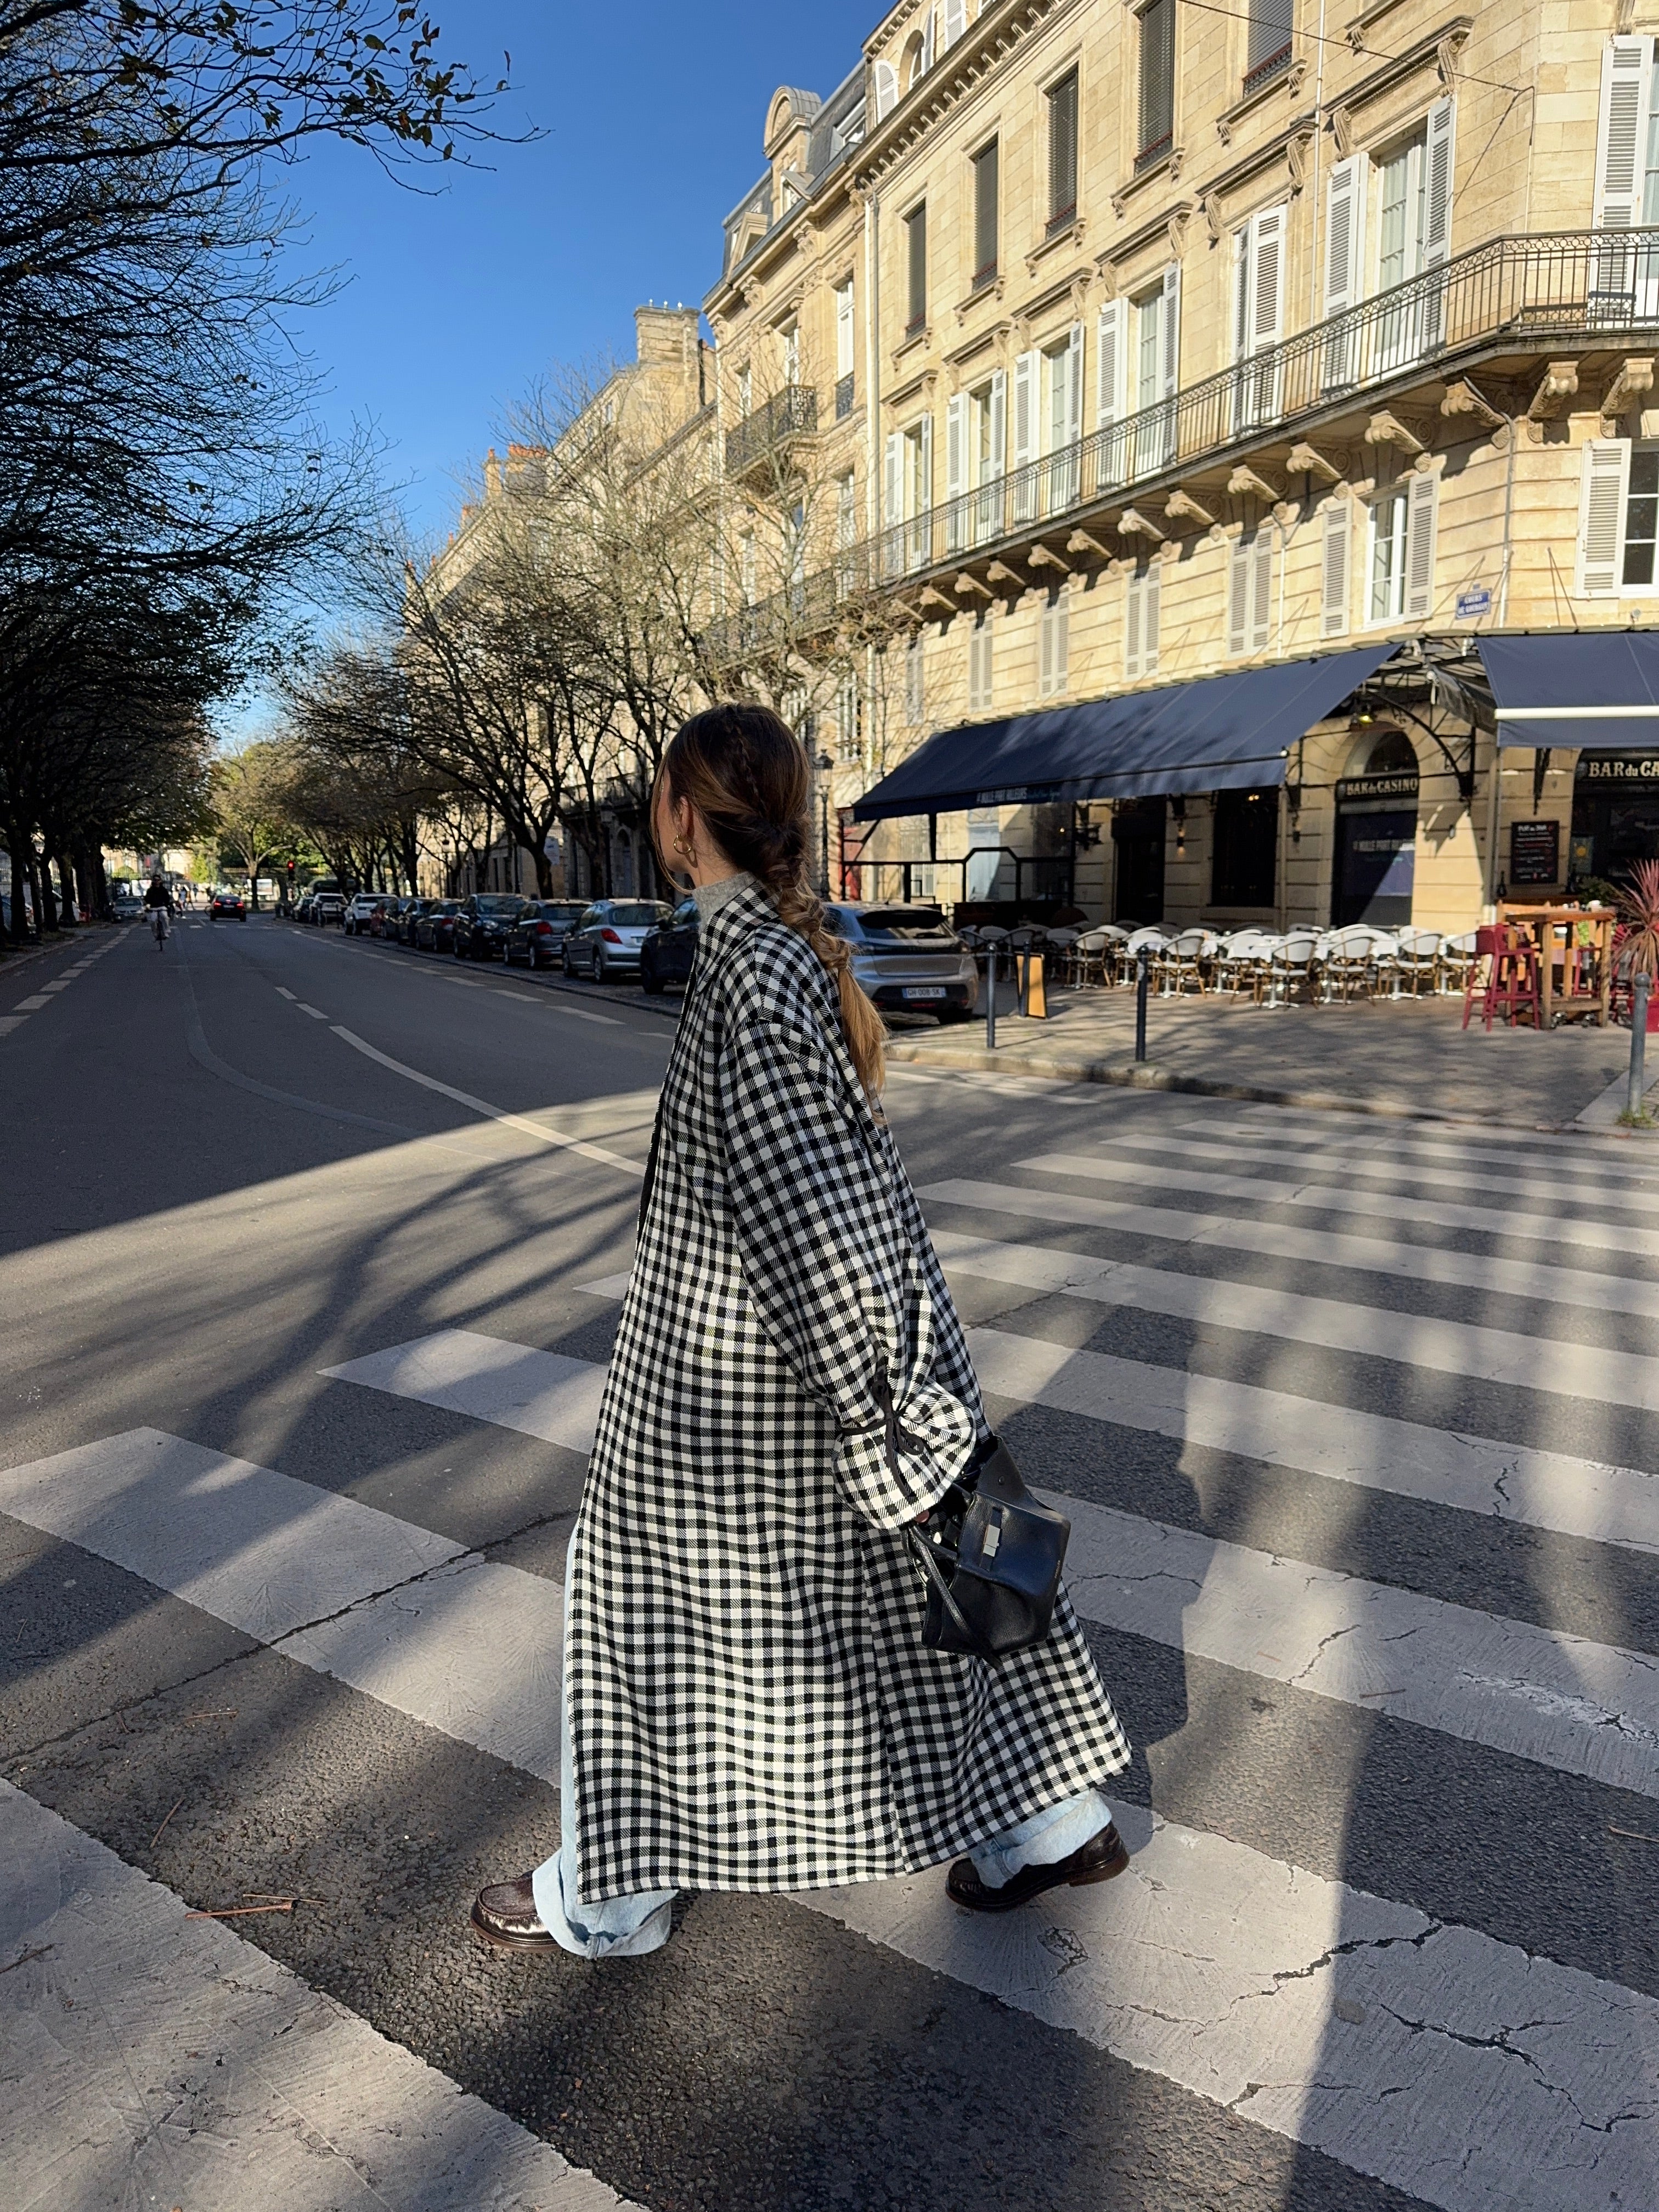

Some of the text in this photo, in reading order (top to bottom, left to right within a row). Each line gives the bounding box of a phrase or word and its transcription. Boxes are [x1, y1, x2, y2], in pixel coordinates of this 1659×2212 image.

[1588, 761, 1624, 777] BAR
[1625, 764, 1638, 776] du
[1346, 781, 1368, 795] BAR
[1377, 777, 1418, 793] CASINO
